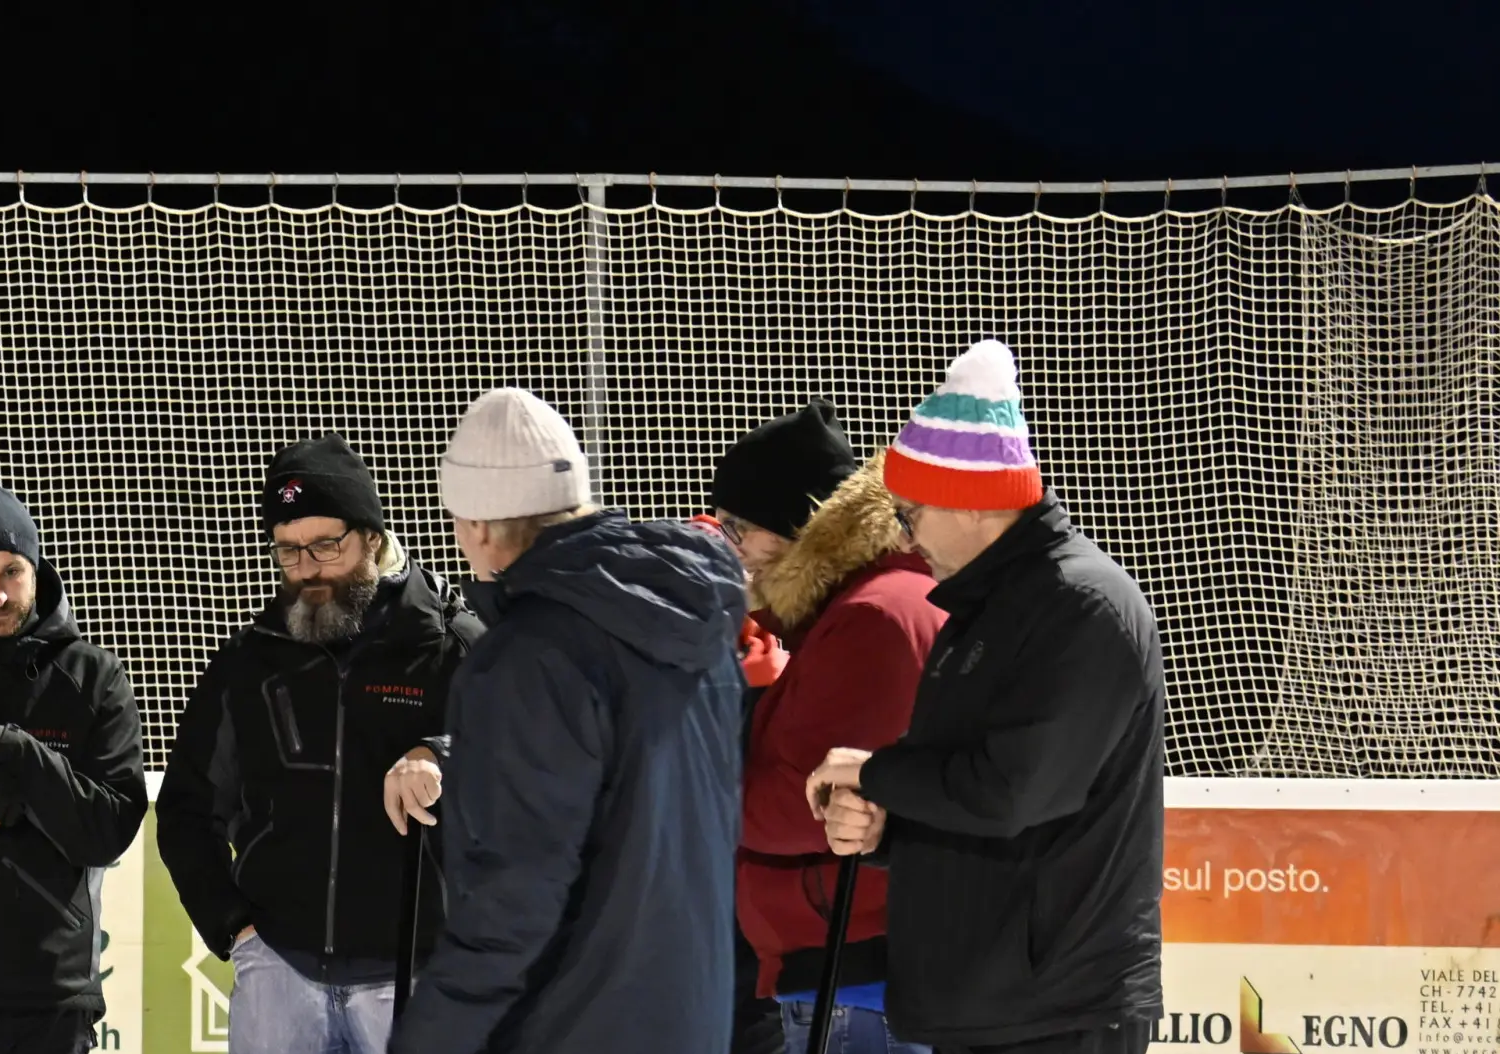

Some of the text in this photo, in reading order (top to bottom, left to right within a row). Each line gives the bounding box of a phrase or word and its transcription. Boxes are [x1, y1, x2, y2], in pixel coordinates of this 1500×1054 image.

[1163, 860, 1329, 899] sul posto.
[1421, 969, 1464, 982] VIALE
[1419, 1000, 1454, 1014] TEL.
[1419, 1015, 1452, 1029] FAX
